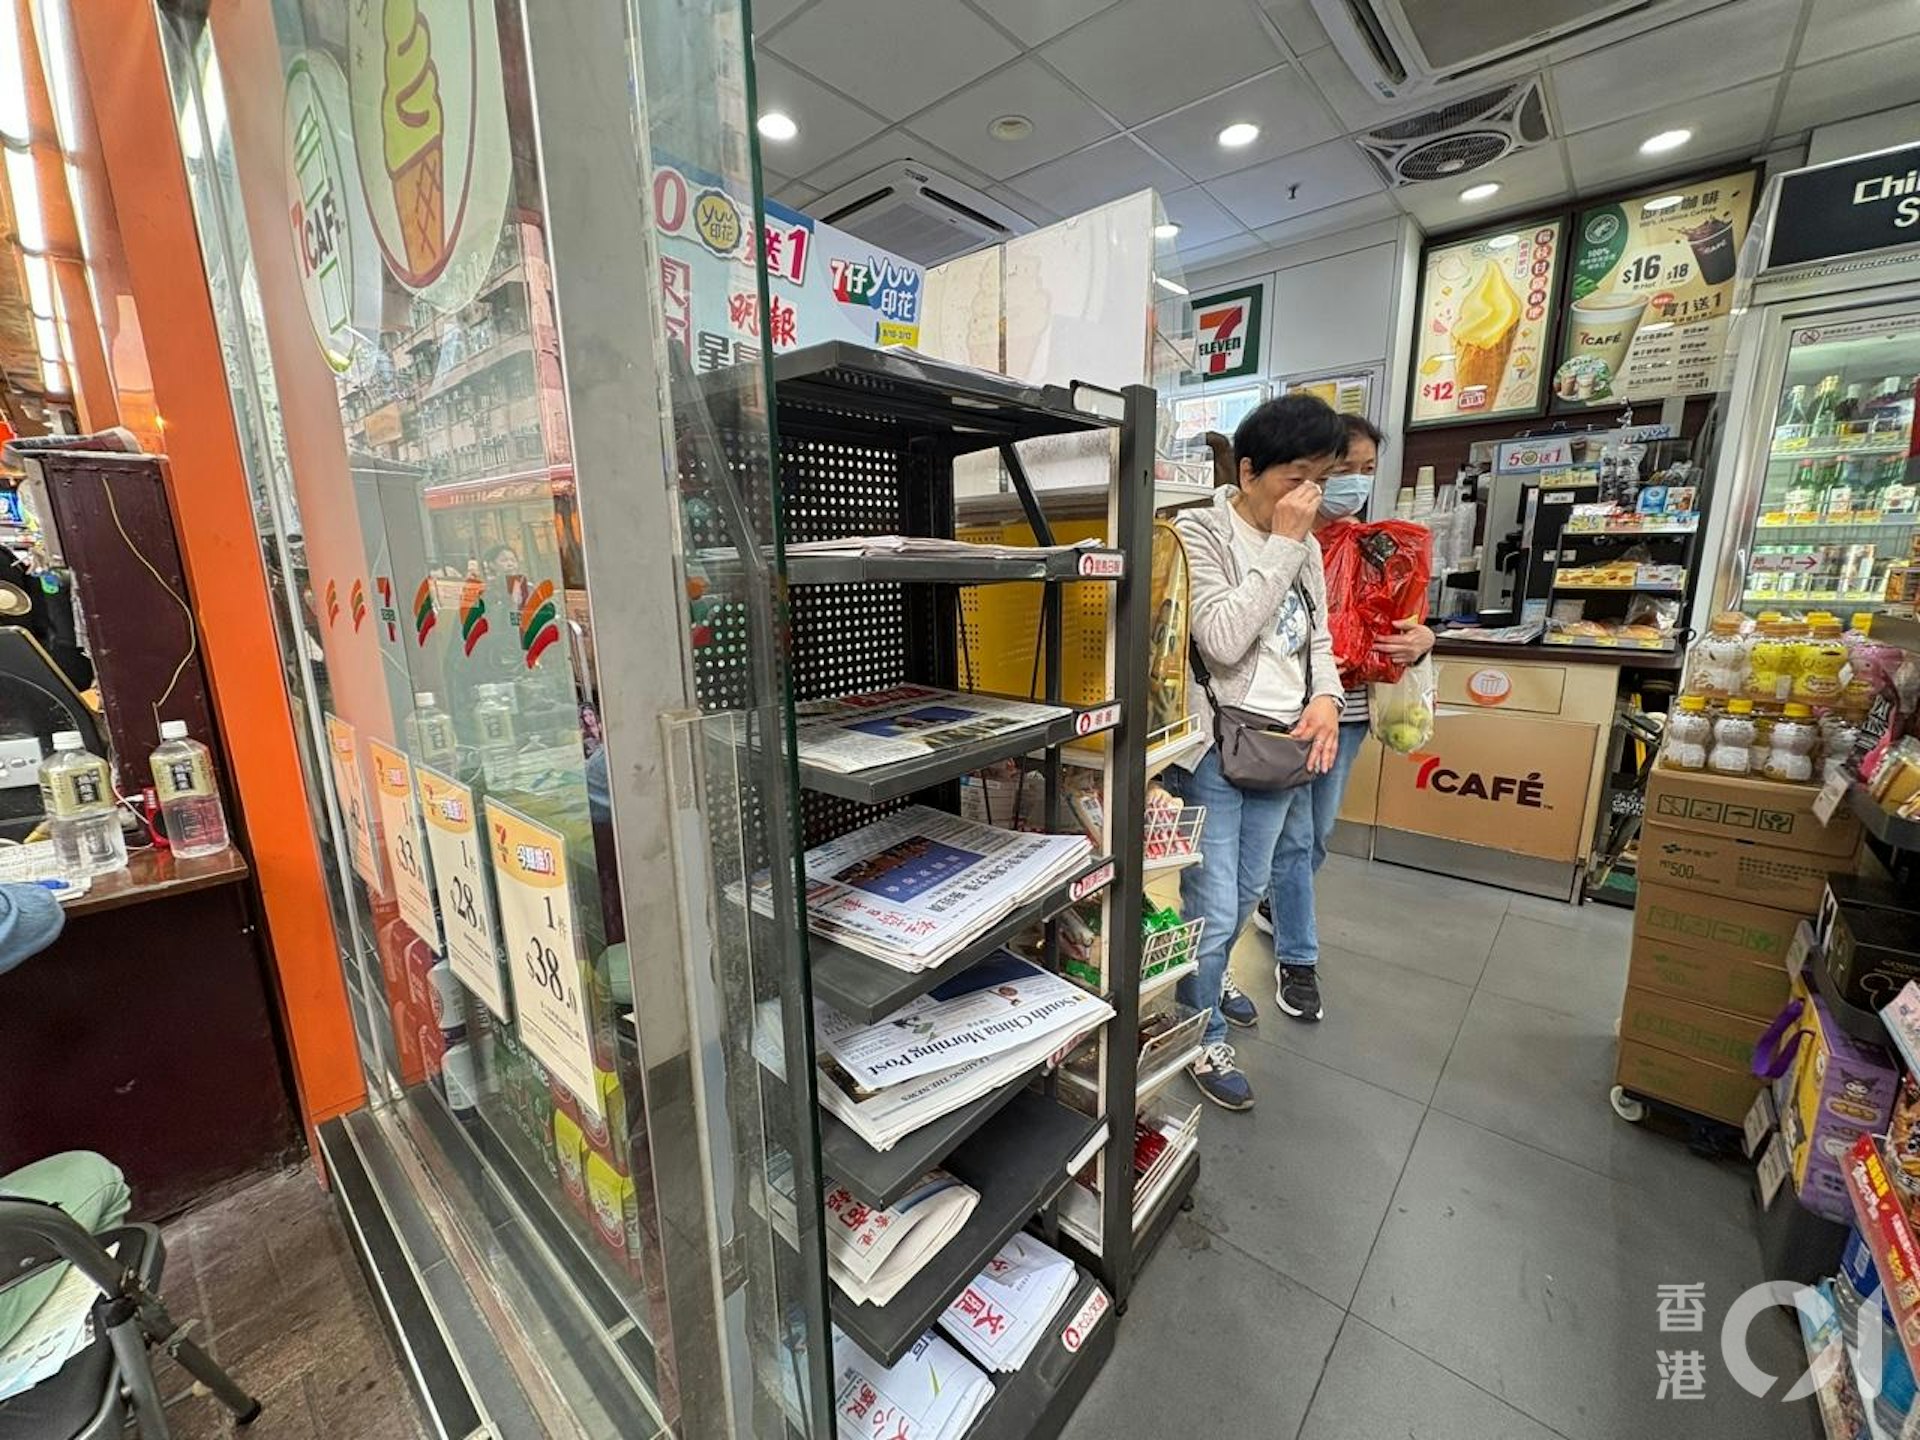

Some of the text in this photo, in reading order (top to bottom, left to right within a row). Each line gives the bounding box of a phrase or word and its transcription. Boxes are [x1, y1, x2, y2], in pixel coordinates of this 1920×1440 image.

[702, 204, 734, 226] yuu
[710, 222, 733, 242] 印花
[1623, 254, 1662, 285] $16
[1667, 263, 1689, 280] $18
[881, 290, 914, 319] 印花
[1423, 382, 1454, 401] $12
[1408, 751, 1544, 808] 7CAFÉ
[1031, 997, 1076, 1022] South
[986, 1013, 1034, 1038] China
[908, 1027, 984, 1060] Morning
[867, 1053, 912, 1077] Post
[953, 1288, 1007, 1337] 文匯
